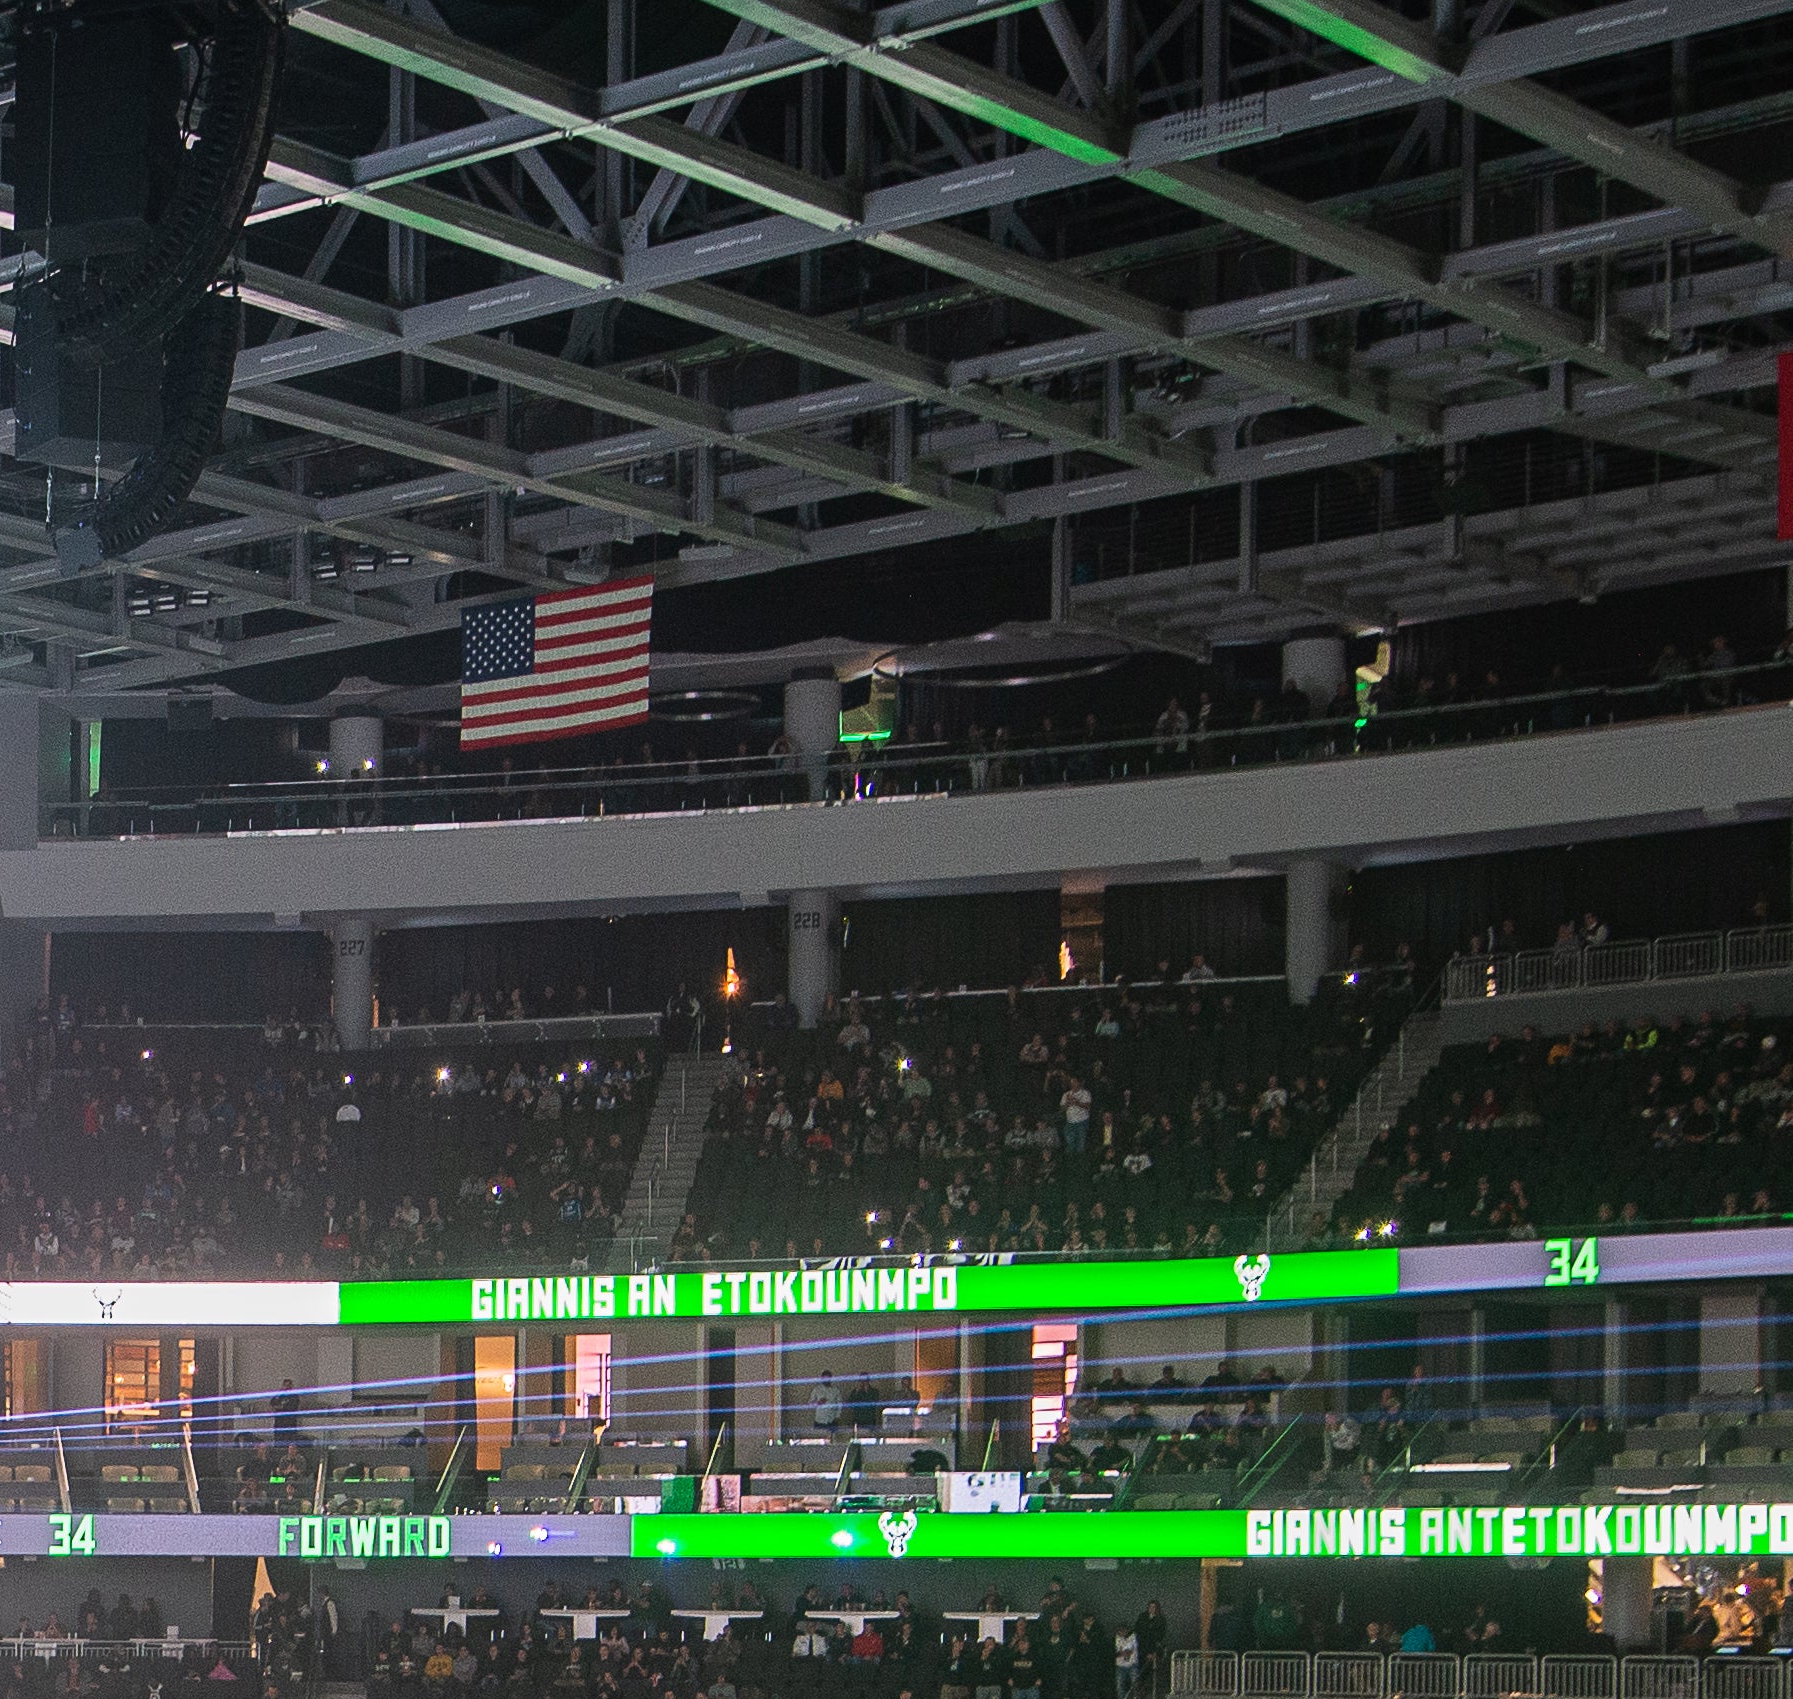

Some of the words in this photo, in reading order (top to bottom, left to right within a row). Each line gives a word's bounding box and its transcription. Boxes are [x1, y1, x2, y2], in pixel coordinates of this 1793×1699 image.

[1544, 1237, 1600, 1287] 34
[471, 1277, 616, 1321] GIANNIS
[628, 1274, 677, 1317] AN
[701, 1266, 958, 1316] ETOKOUNMPO
[48, 1513, 97, 1556] 34
[278, 1515, 452, 1558] FORWARD
[1247, 1507, 1406, 1557] GIANNIS
[1419, 1503, 1793, 1557] ANTETOKOUNMPO
